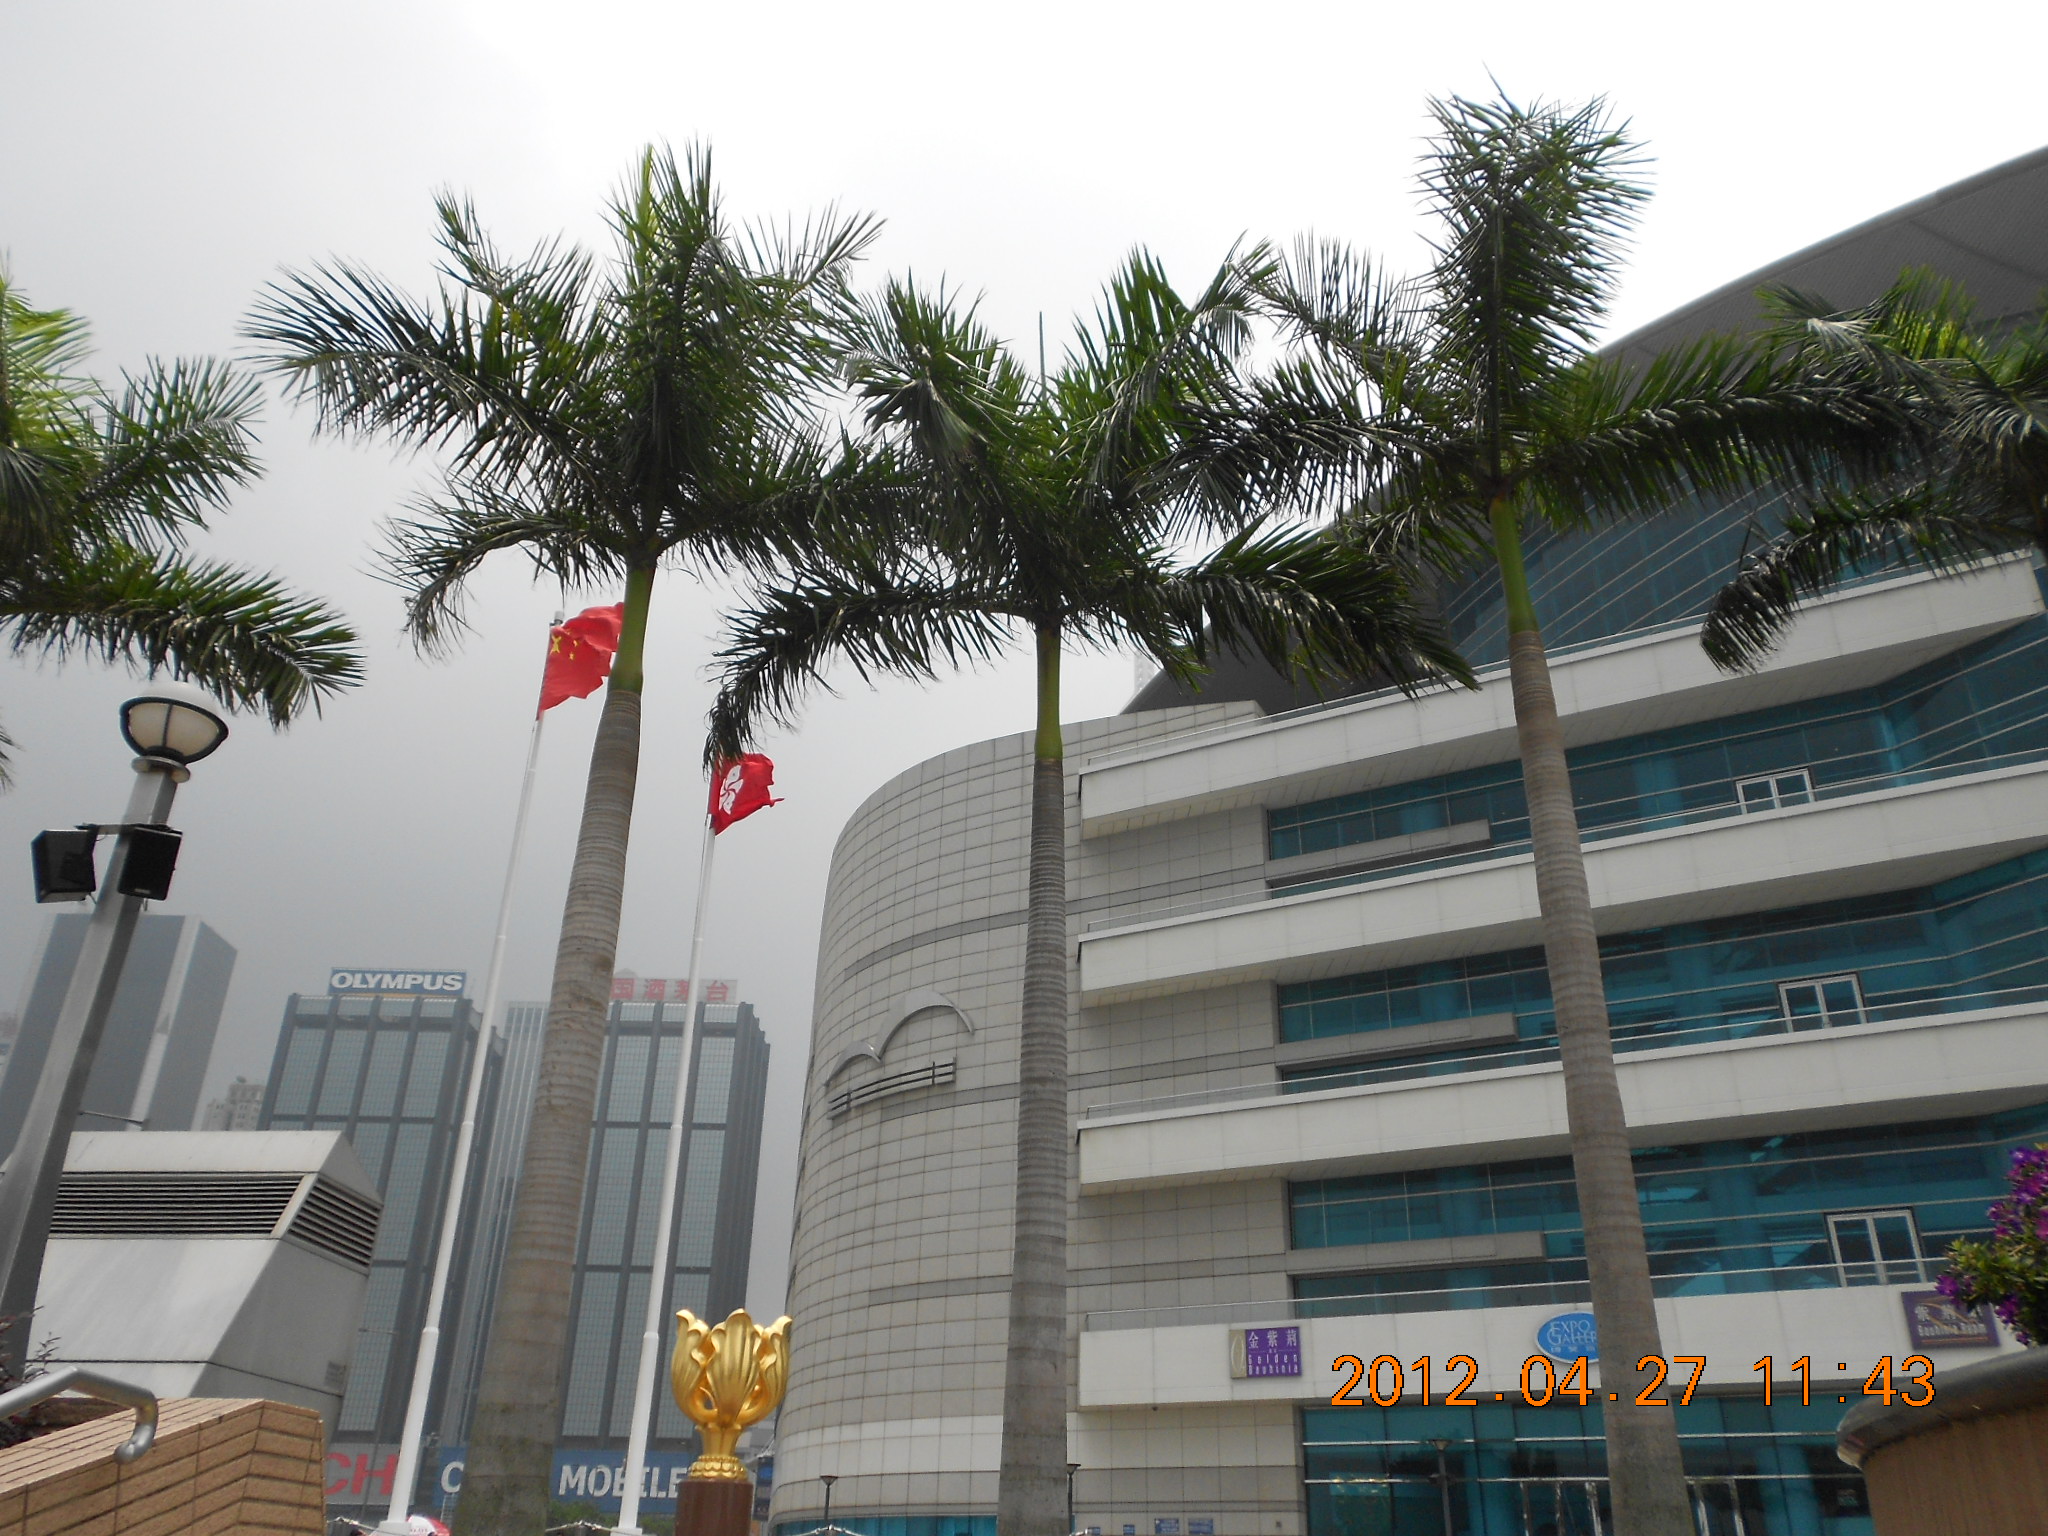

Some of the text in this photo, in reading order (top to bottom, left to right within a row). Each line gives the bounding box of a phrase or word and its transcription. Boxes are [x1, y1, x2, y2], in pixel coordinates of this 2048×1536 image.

[331, 972, 463, 991] OLYMPUS
[1551, 1320, 1590, 1334] EXPO
[1248, 1353, 1298, 1365] Golden
